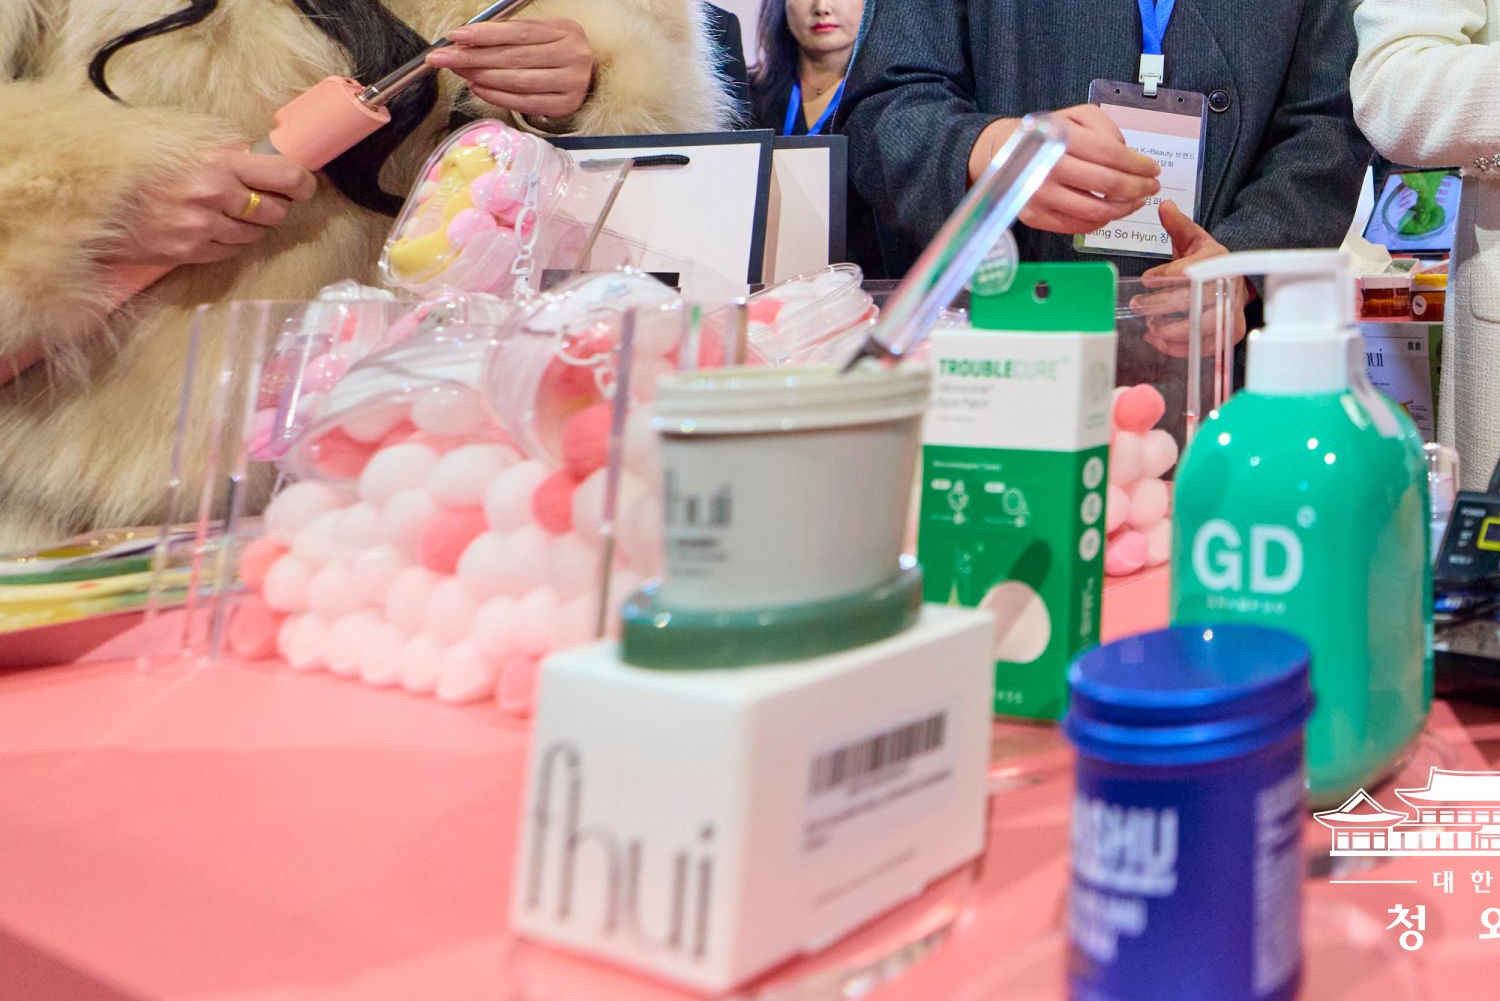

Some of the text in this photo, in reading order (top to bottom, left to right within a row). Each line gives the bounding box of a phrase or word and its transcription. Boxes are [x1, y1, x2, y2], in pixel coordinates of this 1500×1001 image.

[1114, 228, 1129, 239] So
[1131, 230, 1157, 243] Hyun
[1192, 518, 1304, 594] GD
